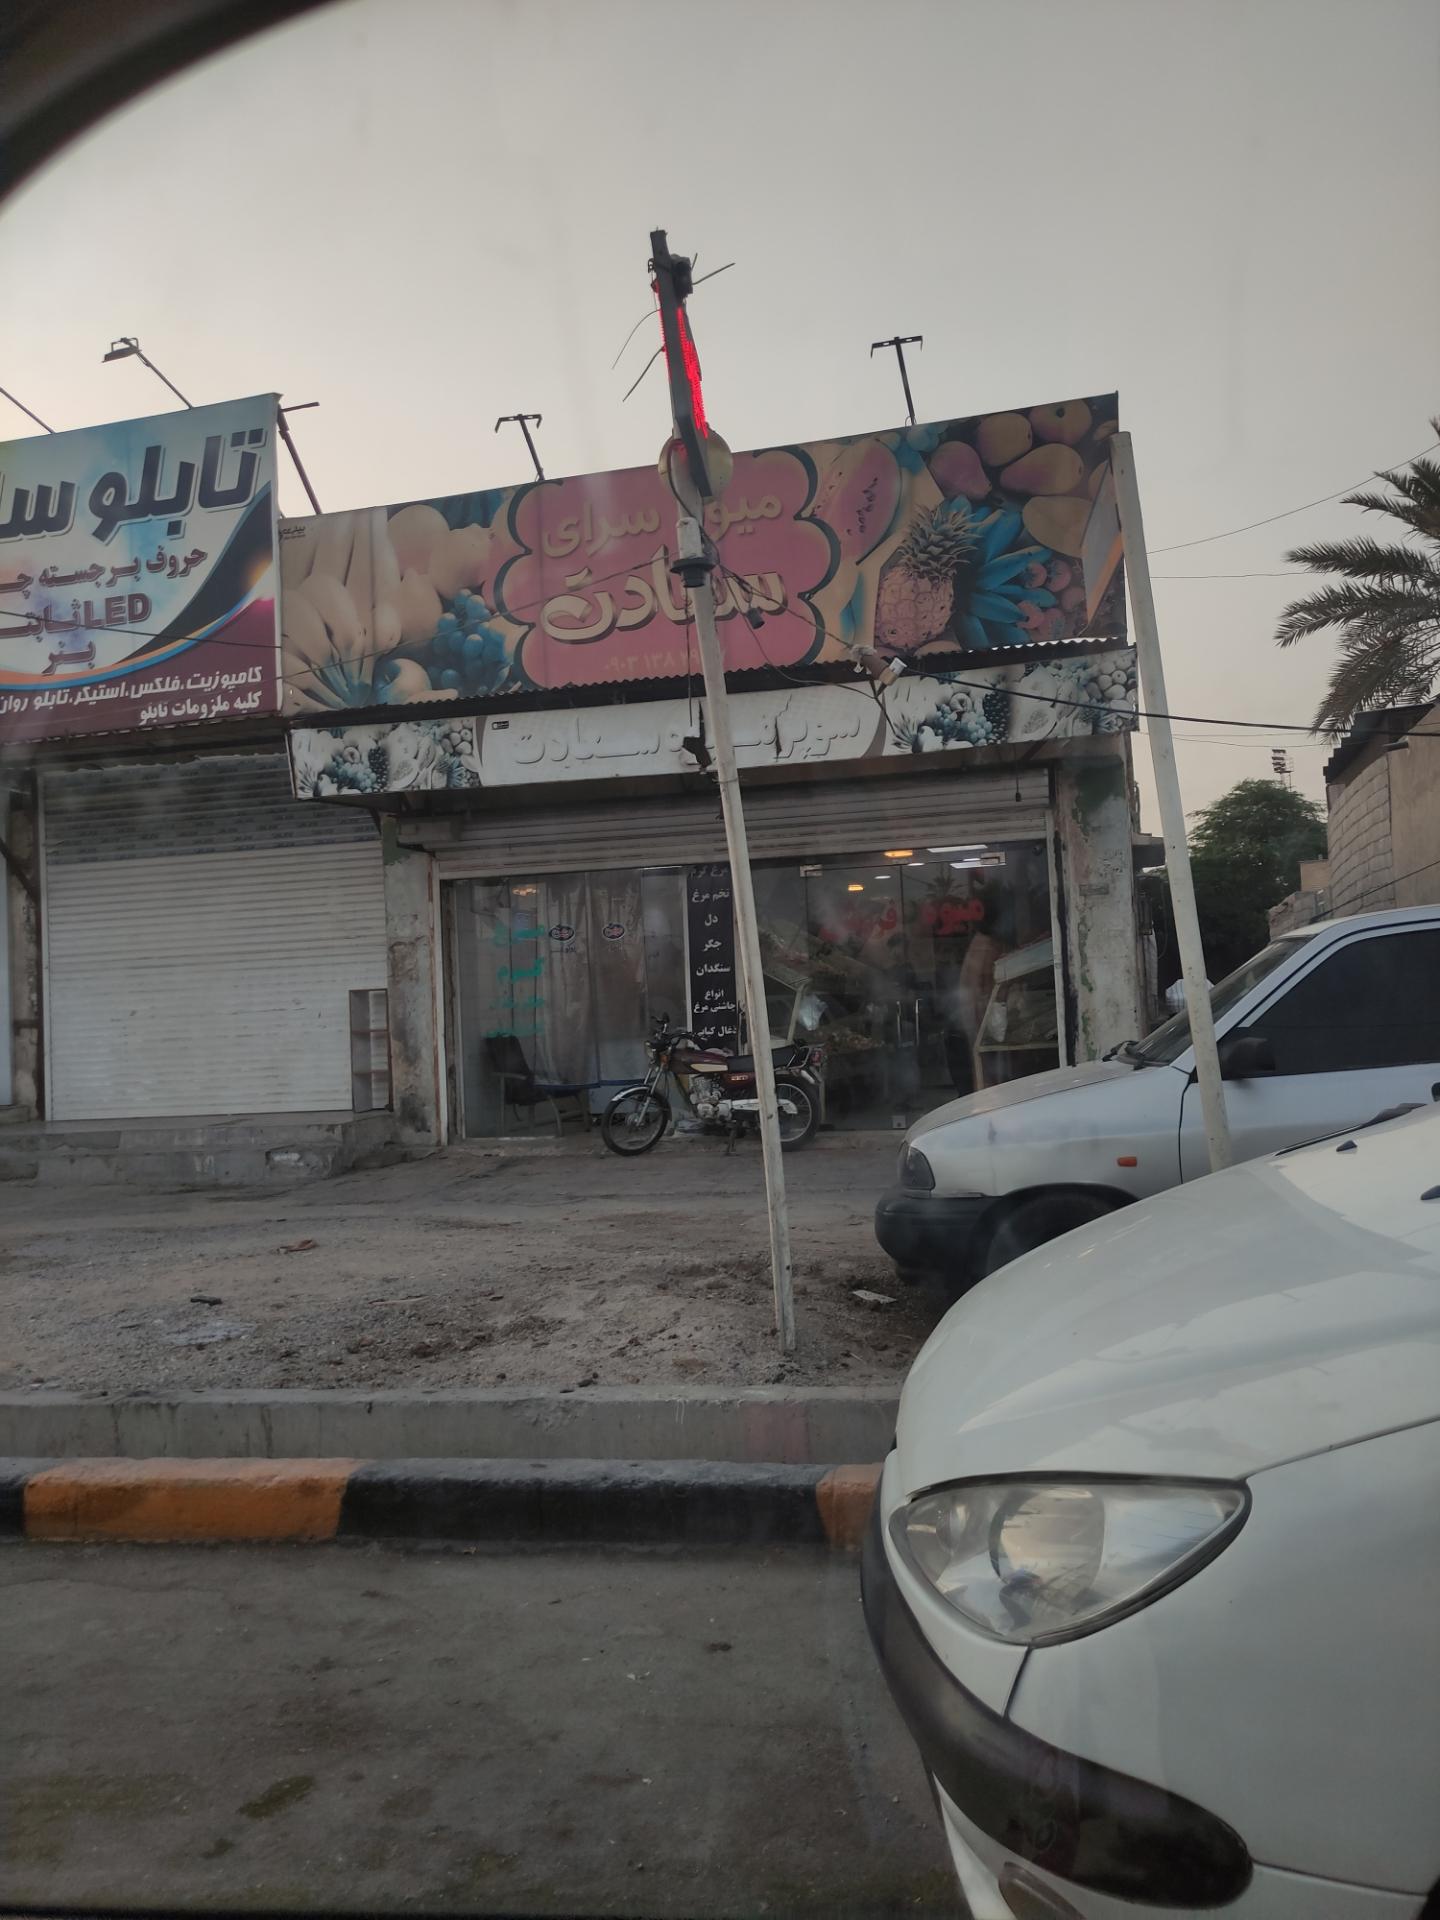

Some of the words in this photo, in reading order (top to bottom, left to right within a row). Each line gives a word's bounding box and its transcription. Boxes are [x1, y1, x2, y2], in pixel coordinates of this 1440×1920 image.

[89, 428, 267, 545] تابلو
[0, 476, 78, 542] س
[703, 494, 783, 542] میو
[543, 502, 661, 558] سرای
[146, 544, 208, 579] حروف
[0, 572, 34, 600] چ
[540, 543, 788, 643] سادت
[84, 593, 152, 629] LED
[42, 639, 97, 676] بنر
[33, 688, 70, 711] تابلو
[171, 694, 230, 719] ملزومات
[233, 690, 263, 714] کلیه
[137, 702, 169, 726] تابلو
[692, 888, 710, 903] مرغ
[704, 913, 719, 926] دل
[693, 1001, 710, 1014] مرغ
[704, 988, 725, 1001] انواع
